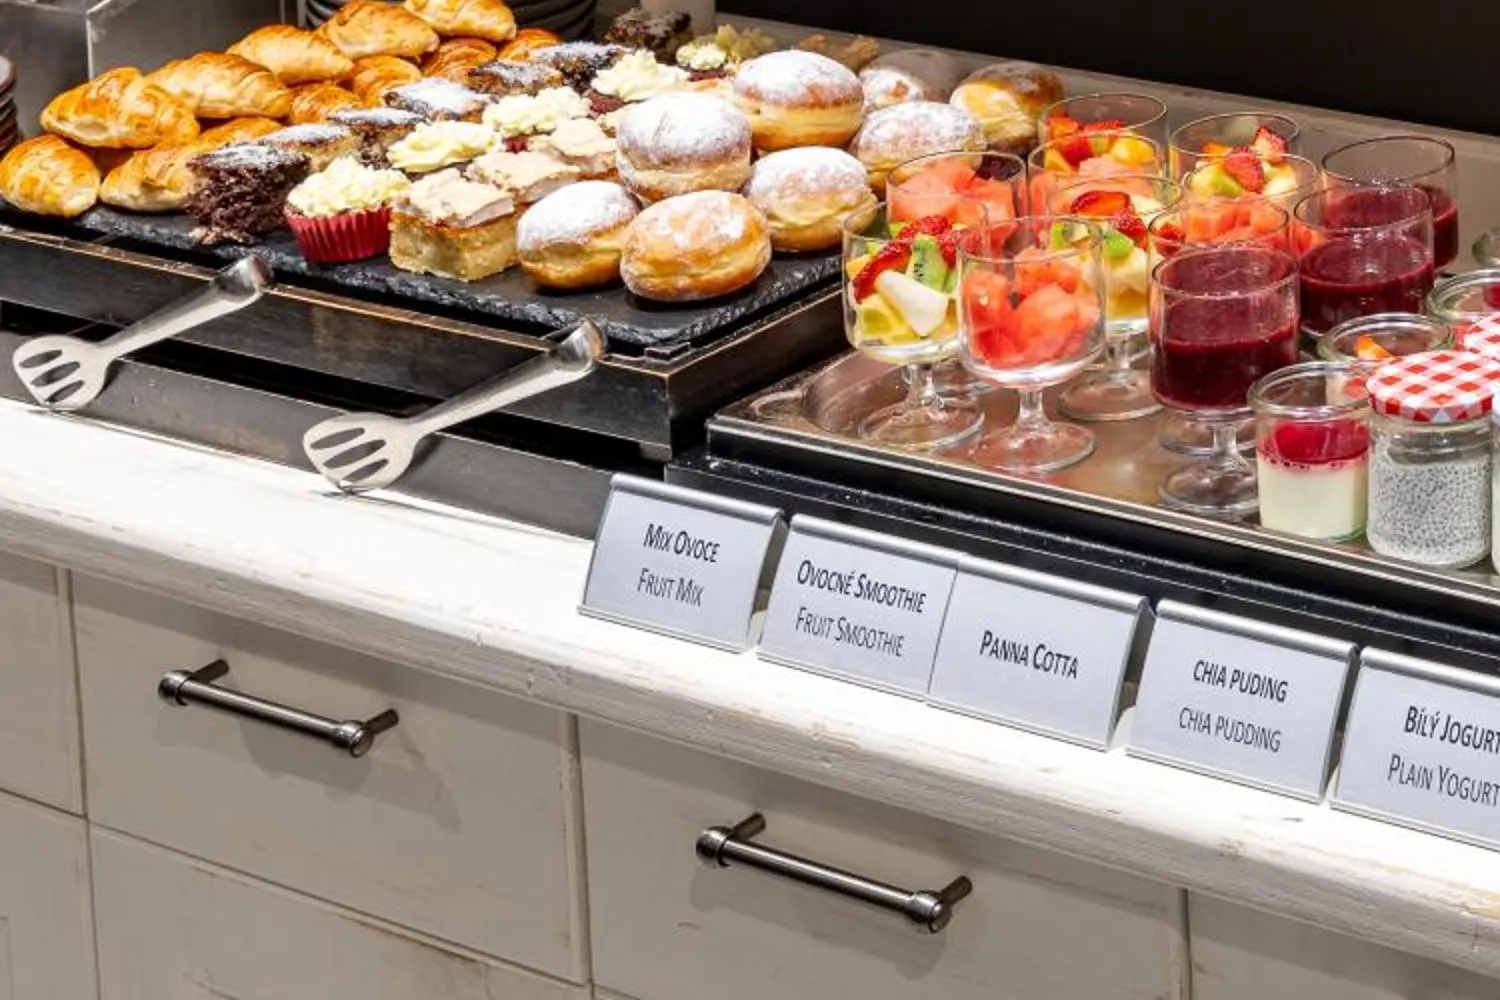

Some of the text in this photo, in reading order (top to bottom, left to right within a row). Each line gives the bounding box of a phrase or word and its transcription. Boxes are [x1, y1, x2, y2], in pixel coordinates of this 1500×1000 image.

[1192, 659, 1289, 704] CHIA PUDING
[1178, 706, 1282, 754] CHIA PUDDING
